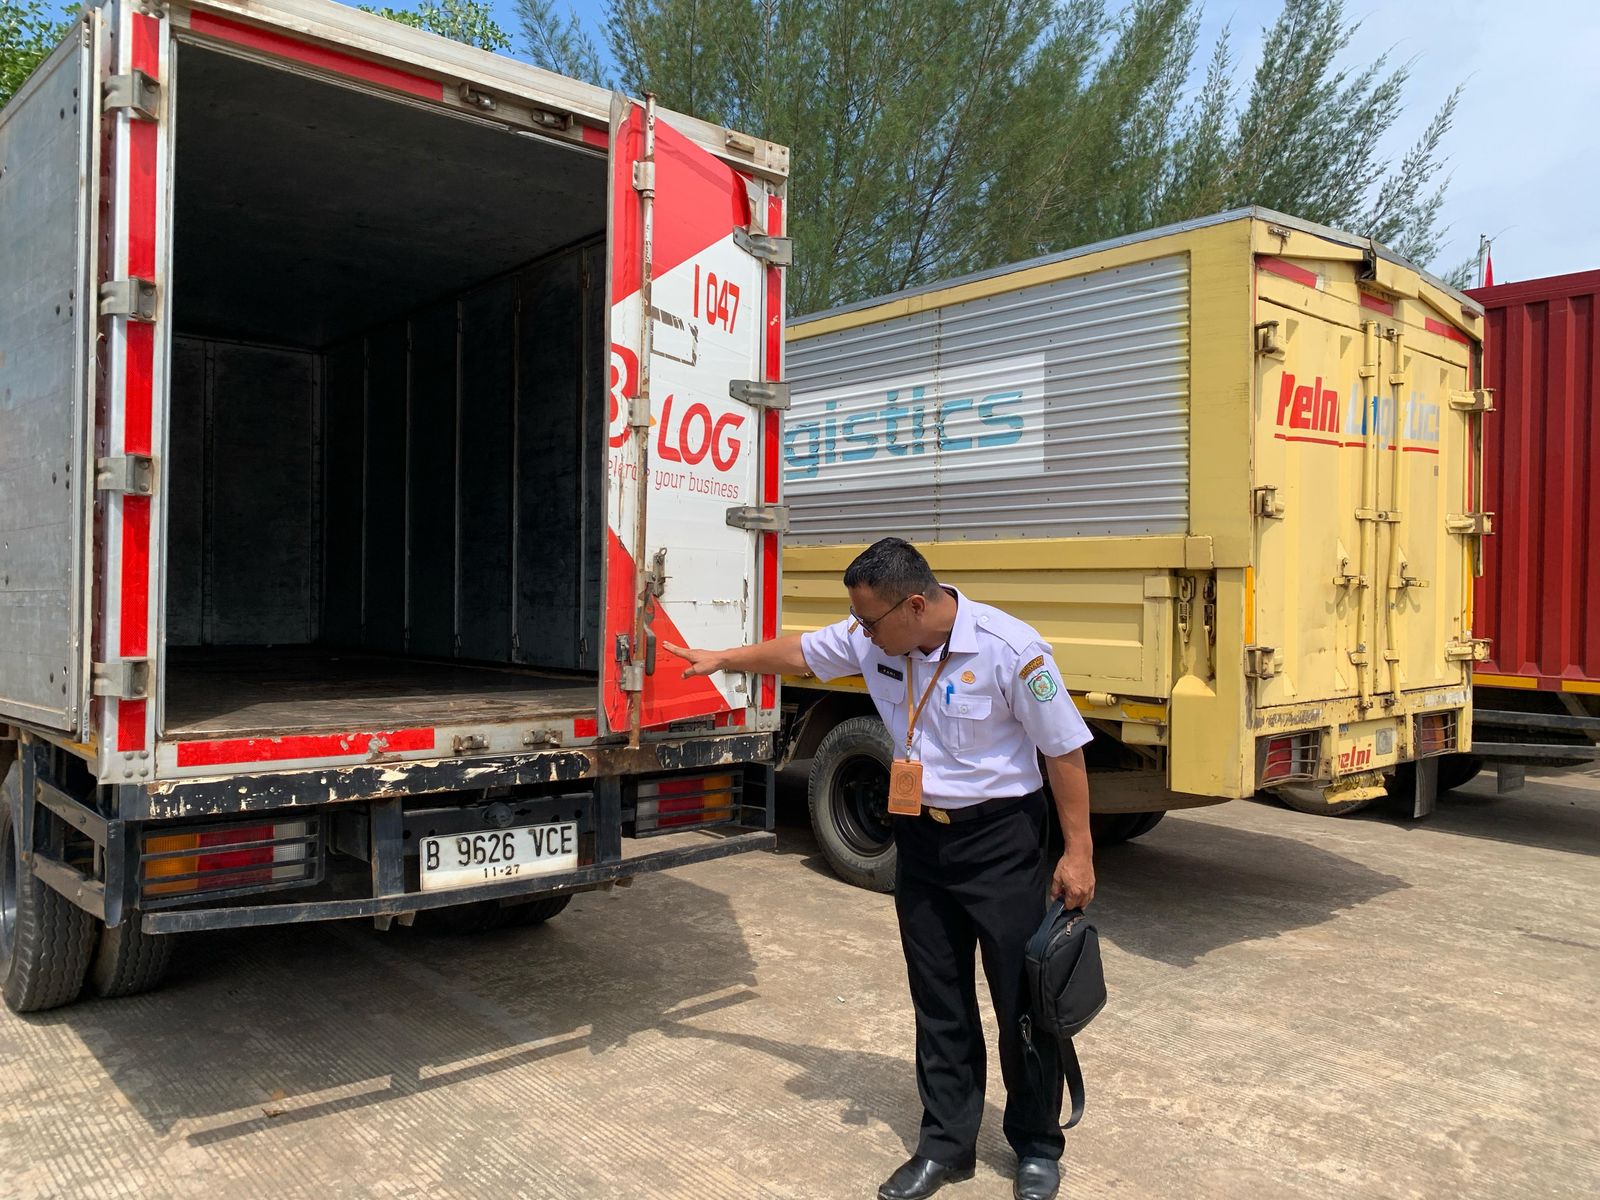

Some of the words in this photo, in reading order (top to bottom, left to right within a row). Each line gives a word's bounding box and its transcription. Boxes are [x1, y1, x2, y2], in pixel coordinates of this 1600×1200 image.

[657, 394, 745, 472] LOG
[784, 386, 1025, 481] gistics
[655, 469, 686, 491] your
[688, 474, 739, 499] business
[426, 840, 440, 871] B
[456, 832, 515, 866] 9626
[528, 825, 573, 857] VCE
